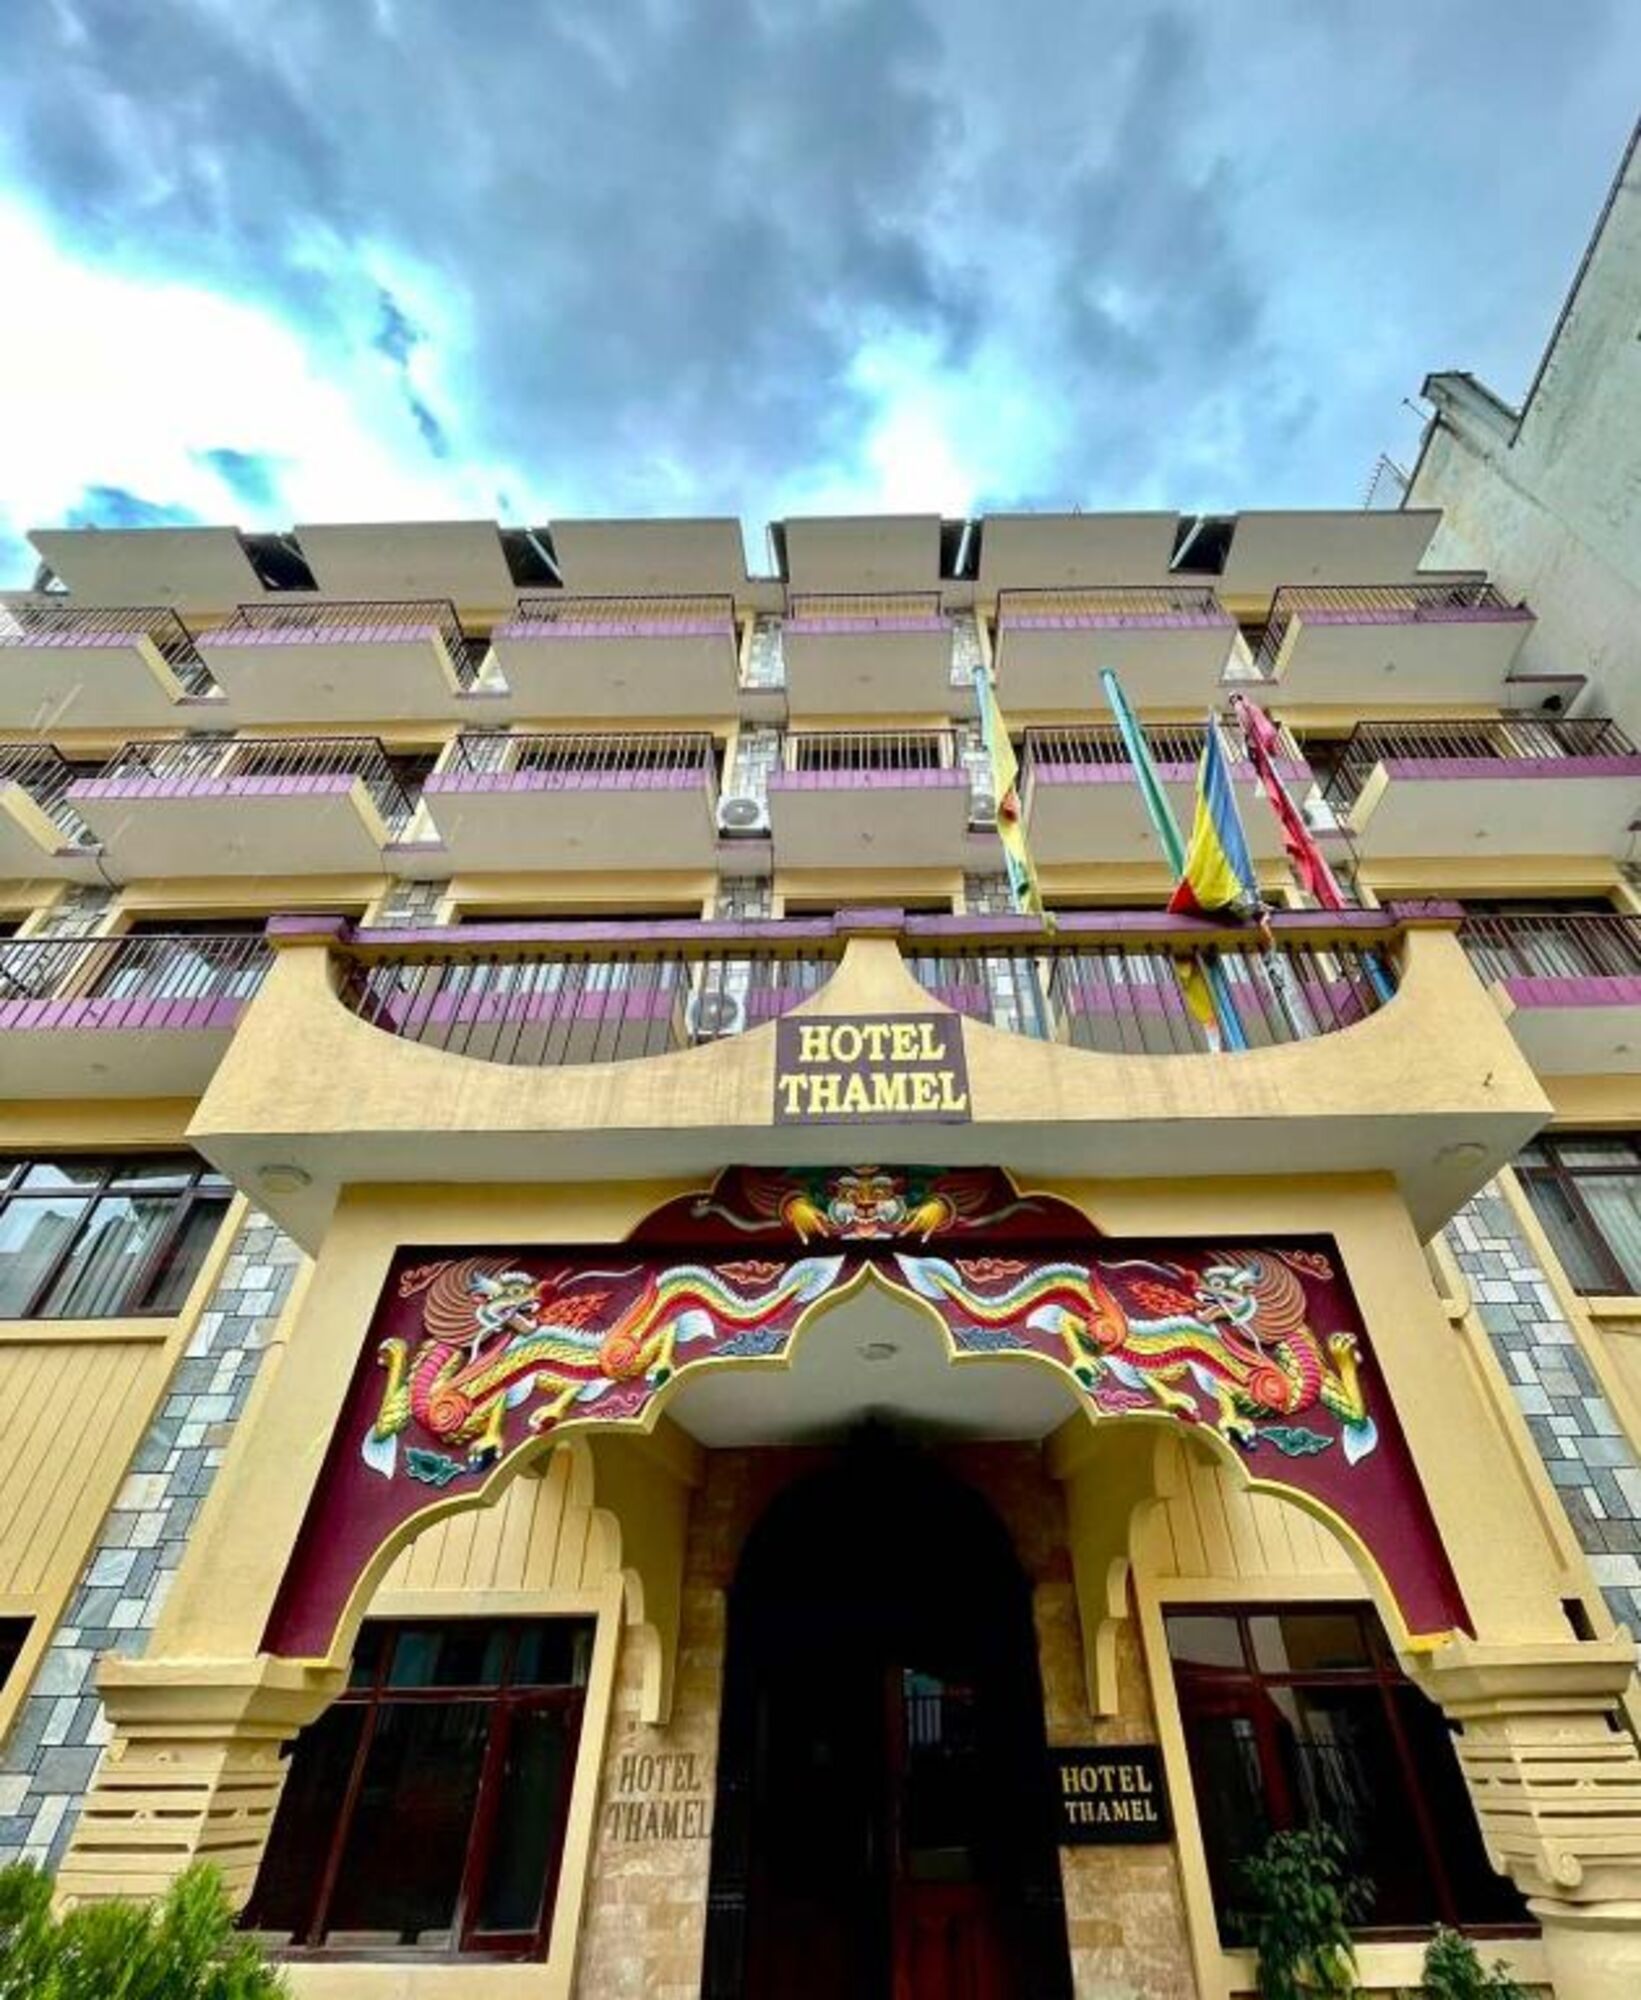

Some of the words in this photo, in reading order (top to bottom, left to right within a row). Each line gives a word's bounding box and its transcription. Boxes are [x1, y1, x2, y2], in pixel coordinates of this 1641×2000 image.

[799, 1023, 946, 1062] HOTEL
[778, 1072, 967, 1114] THAMEL
[619, 1753, 701, 1792] HOTEL
[1060, 1764, 1153, 1793] HOTEL
[607, 1799, 710, 1842] THAMEL
[1065, 1799, 1158, 1824] THAMEL
